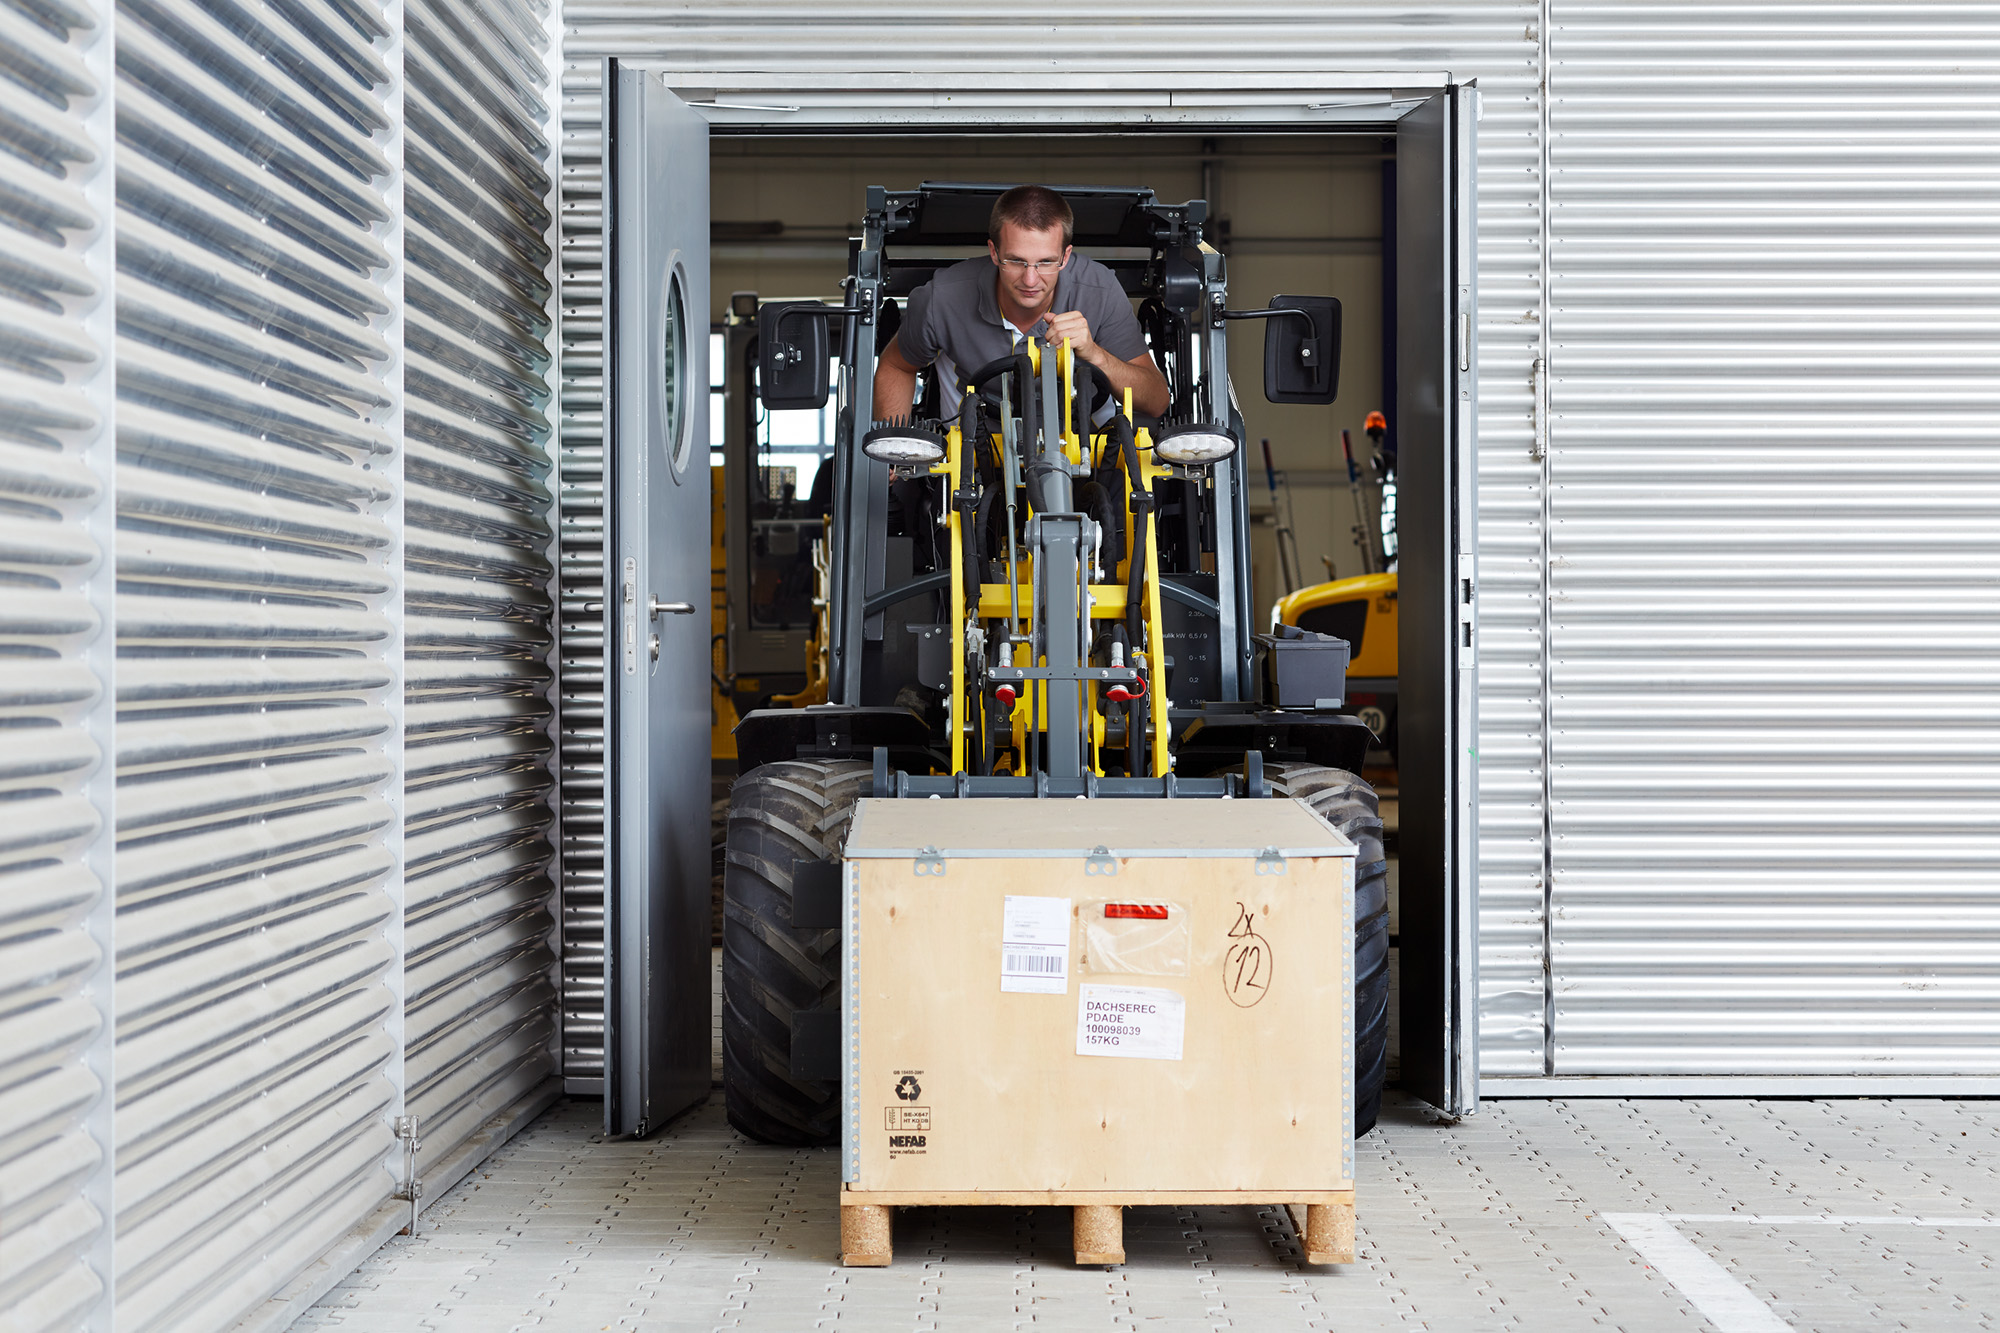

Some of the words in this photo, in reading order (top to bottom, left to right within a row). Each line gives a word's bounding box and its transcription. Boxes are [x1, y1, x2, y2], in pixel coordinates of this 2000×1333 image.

[1086, 1001, 1156, 1014] DACHSEREC
[1086, 1012, 1125, 1023] PDADE
[1086, 1024, 1141, 1036] 100098039
[1085, 1035, 1120, 1046] 157KG
[889, 1135, 926, 1147] NEFAB
